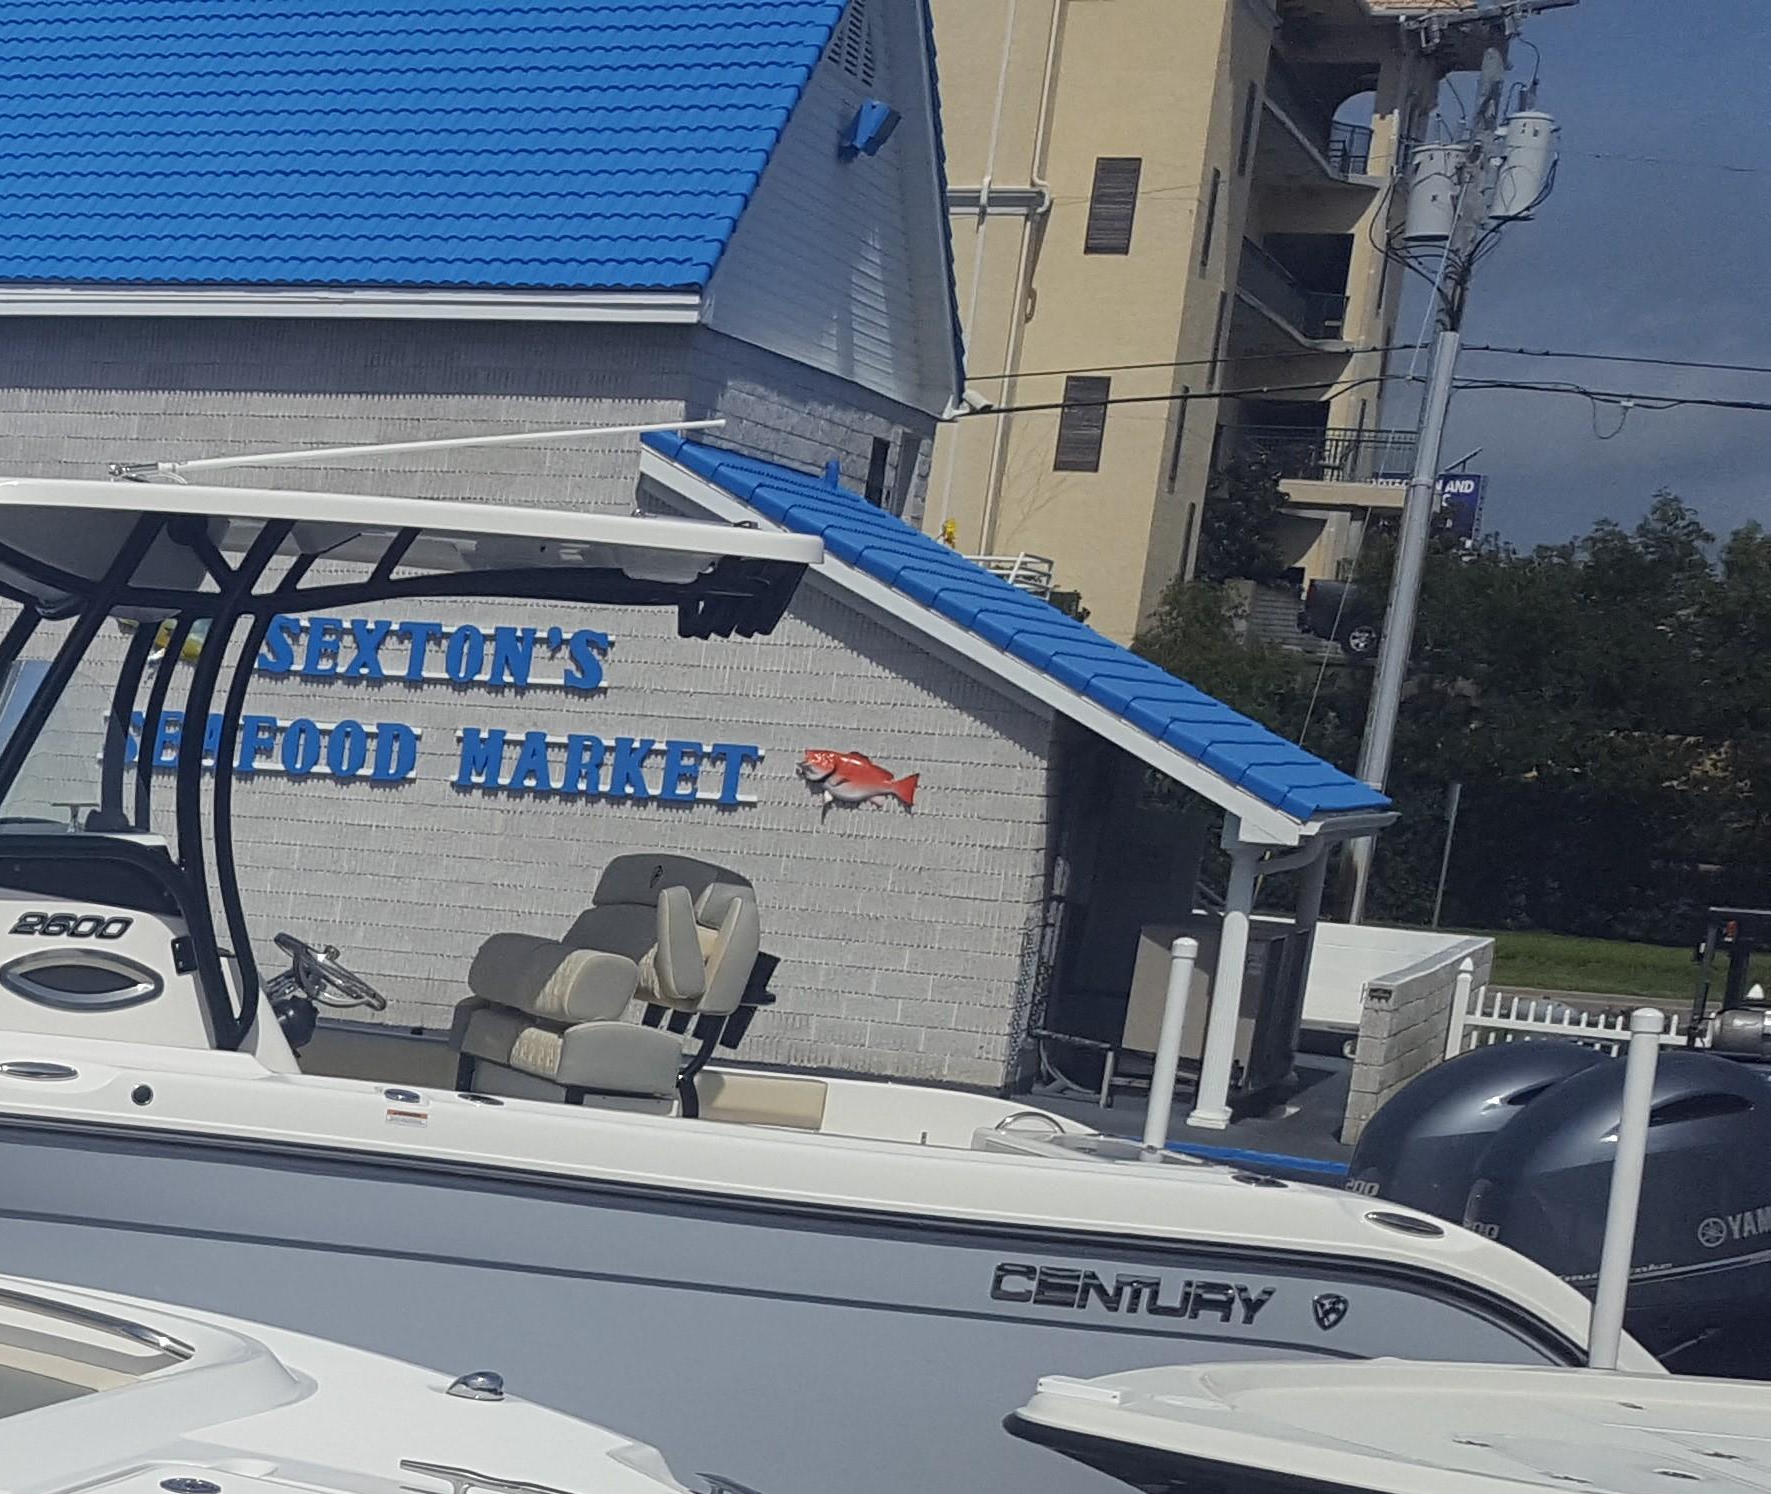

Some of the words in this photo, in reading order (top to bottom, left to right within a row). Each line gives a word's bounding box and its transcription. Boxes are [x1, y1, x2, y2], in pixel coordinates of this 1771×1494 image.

[1445, 479, 1475, 493] AND
[257, 613, 611, 689] SEXTON'S
[453, 727, 760, 805] MARKET
[8, 911, 135, 940] 2600
[1464, 1219, 1500, 1240] 00
[989, 1262, 1277, 1325] CENTURY
